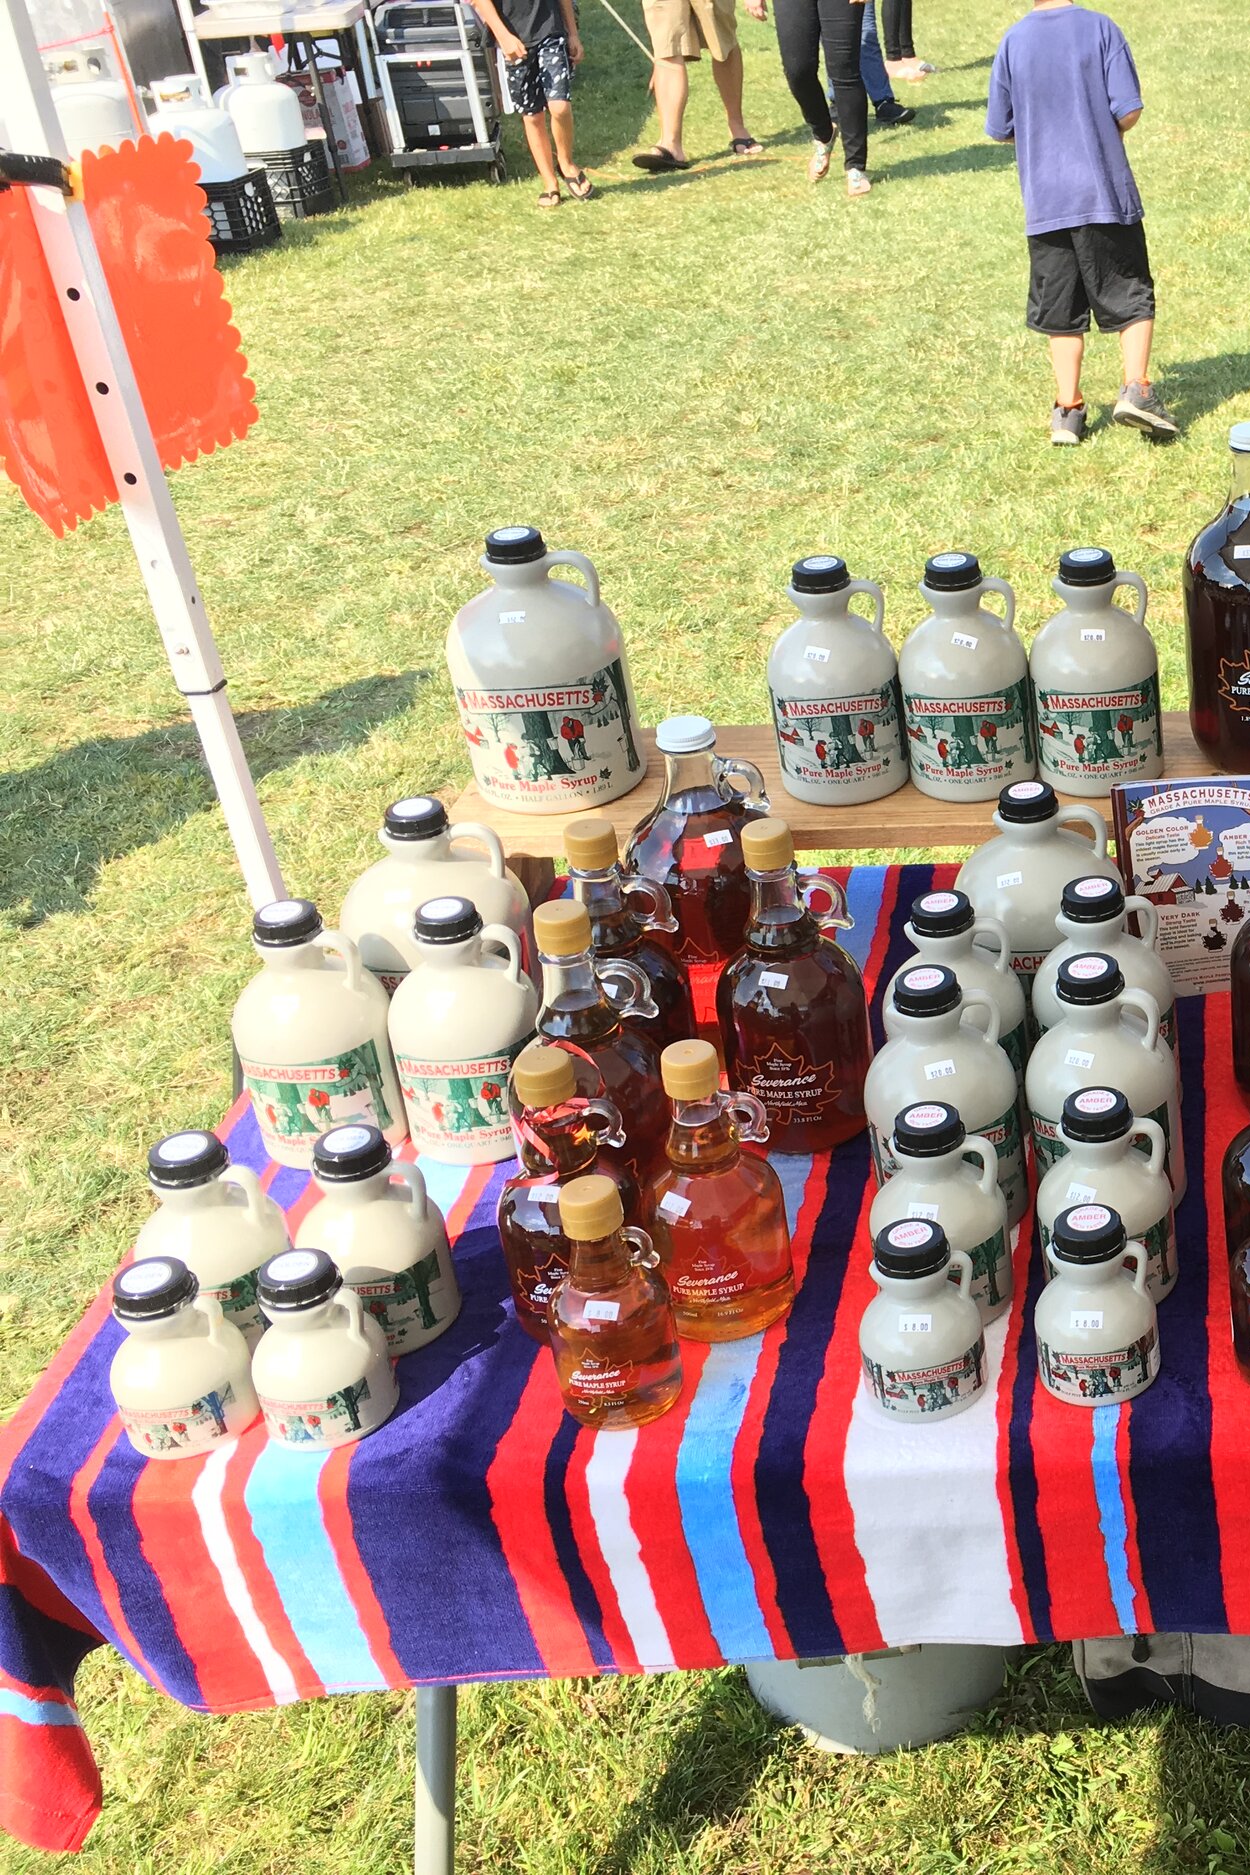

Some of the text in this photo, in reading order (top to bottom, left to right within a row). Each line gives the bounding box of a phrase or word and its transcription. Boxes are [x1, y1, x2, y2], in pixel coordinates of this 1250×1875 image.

[465, 690, 591, 710] MASSACHUSETTS
[914, 698, 1004, 713] MASSACHUSETTS
[1050, 694, 1140, 710] MASSACHUSETTS
[788, 698, 880, 716] MASSACHUSETTS
[802, 763, 882, 780] Pure Maple Syrup
[924, 764, 1004, 779] Pure Maple Syrup
[1060, 758, 1139, 774] Pure Maple Syrup
[491, 773, 598, 794] Pure Maple Syrup
[1150, 804, 1172, 814] GRADE
[1078, 883, 1108, 892] AMBER
[924, 897, 955, 905] AMBER
[1072, 963, 1104, 971] AMBER
[909, 974, 940, 983] AMBER
[405, 1060, 507, 1076] MASSACHUSETTS
[1068, 1055, 1088, 1068] $20.00
[930, 1066, 953, 1079] $20.00
[752, 1074, 817, 1087] Severance
[766, 1091, 793, 1099] MAPLE
[795, 1088, 822, 1098] SYRUP
[444, 1125, 512, 1140] Maple Syrup
[894, 1227, 928, 1242] AMBER
[677, 1270, 738, 1286] Severance
[673, 1286, 691, 1296] PURE
[718, 1283, 744, 1294] SYRUP
[530, 1295, 548, 1303] PURE
[904, 1322, 929, 1331] $ 8.00
[1083, 1319, 1100, 1328] 8.00
[1060, 1354, 1126, 1364] MASSACHUSETTS
[571, 1370, 620, 1380] Severance
[898, 1363, 963, 1382] MASSACHUSETTS
[568, 1378, 582, 1388] PURE
[605, 1380, 626, 1388] SYRUP
